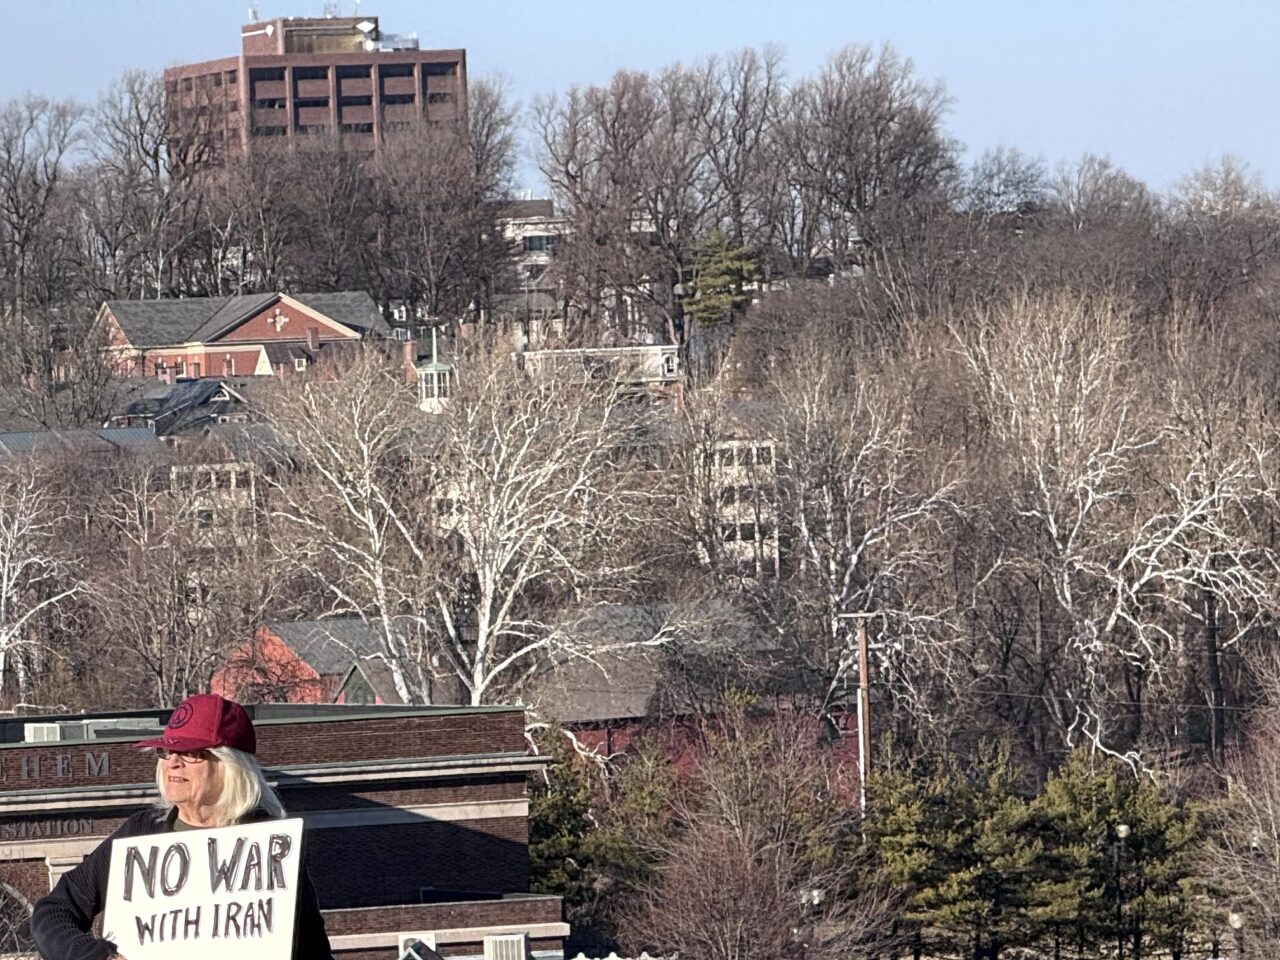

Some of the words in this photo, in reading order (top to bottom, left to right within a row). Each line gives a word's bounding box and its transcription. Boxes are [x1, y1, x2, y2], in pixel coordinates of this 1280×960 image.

[3, 818, 95, 839] STATION
[123, 841, 191, 902] NO
[207, 833, 293, 894] WAR
[135, 905, 201, 946] WITH
[211, 897, 275, 939] IRAN
